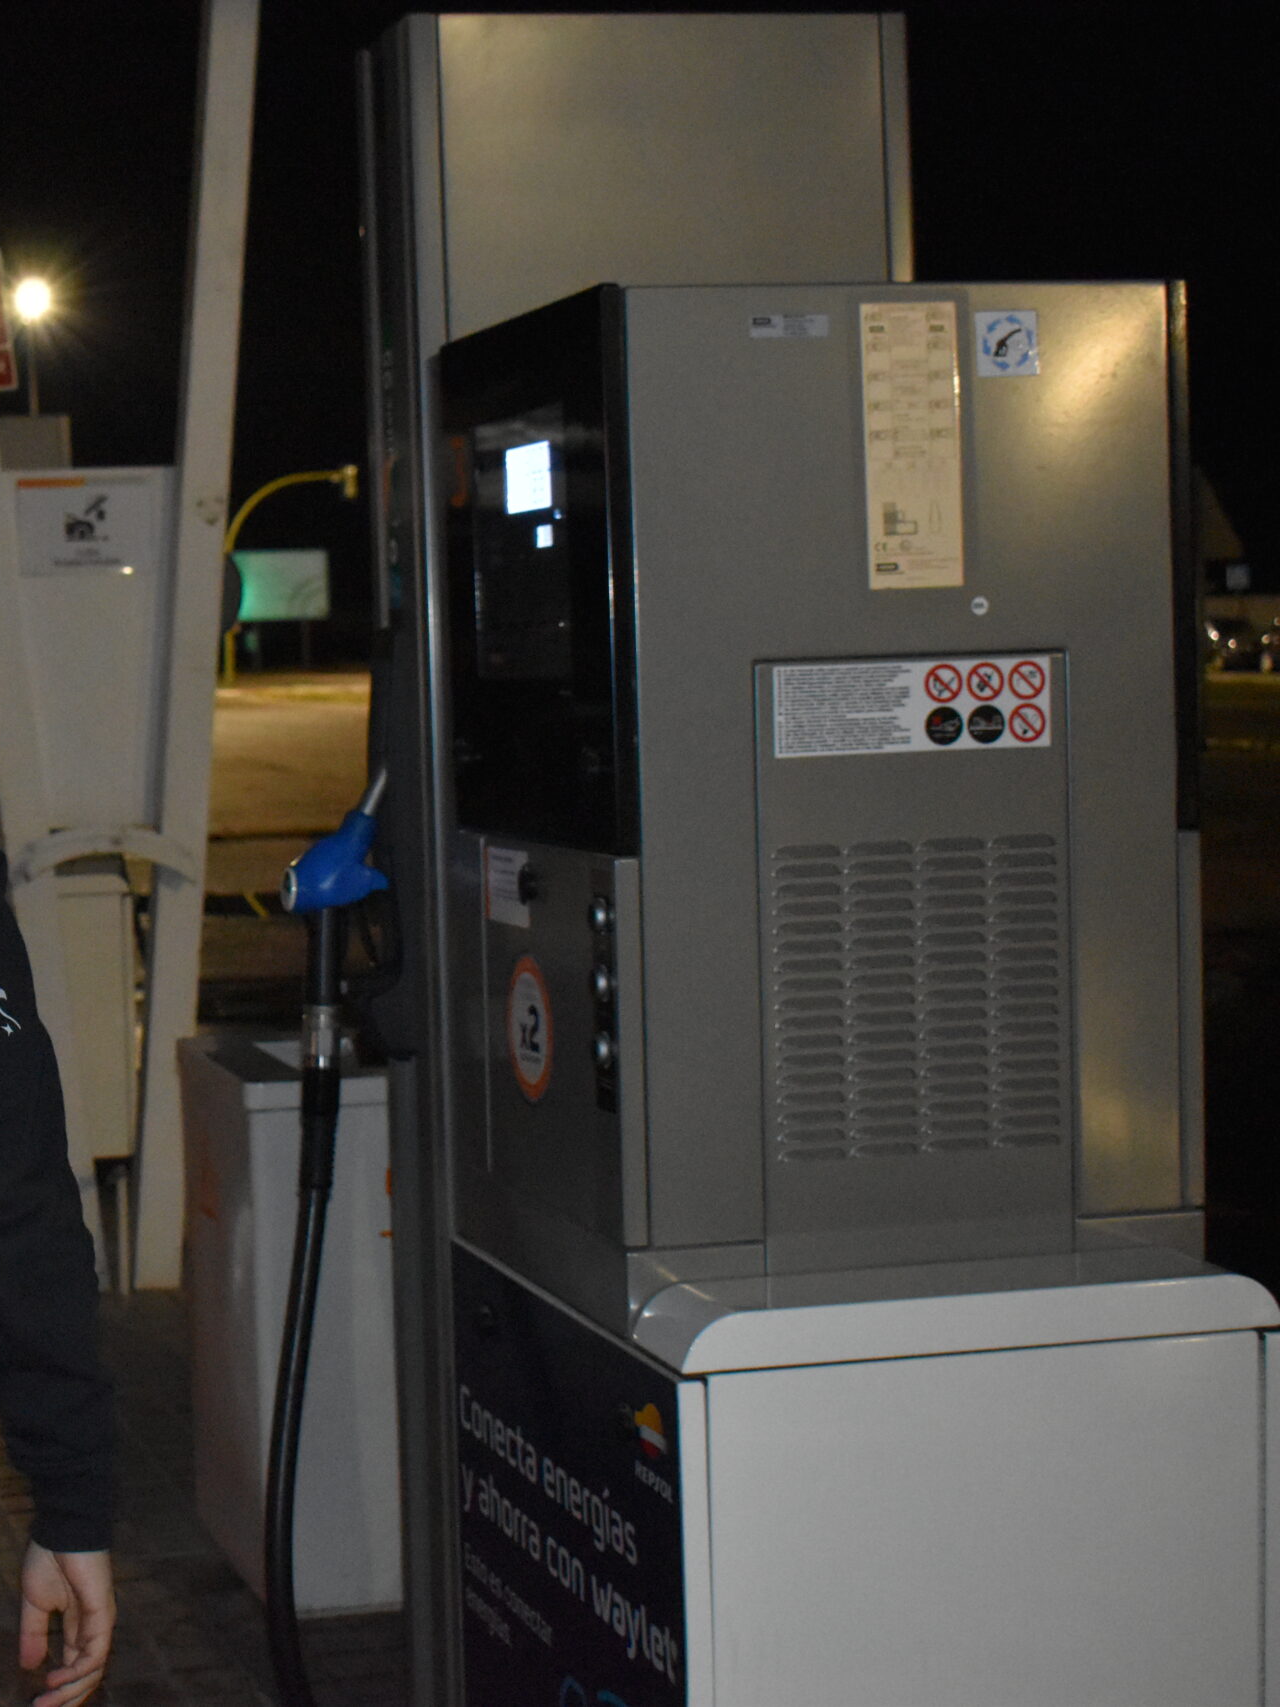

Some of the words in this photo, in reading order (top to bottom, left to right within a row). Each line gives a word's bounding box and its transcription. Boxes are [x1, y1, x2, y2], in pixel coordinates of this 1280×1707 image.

[459, 1384, 538, 1484] Conecta
[542, 1456, 638, 1565] energías
[461, 1463, 474, 1512] y
[478, 1474, 541, 1561] ahorra
[546, 1536, 585, 1602] con
[634, 1458, 674, 1504] REPSOL
